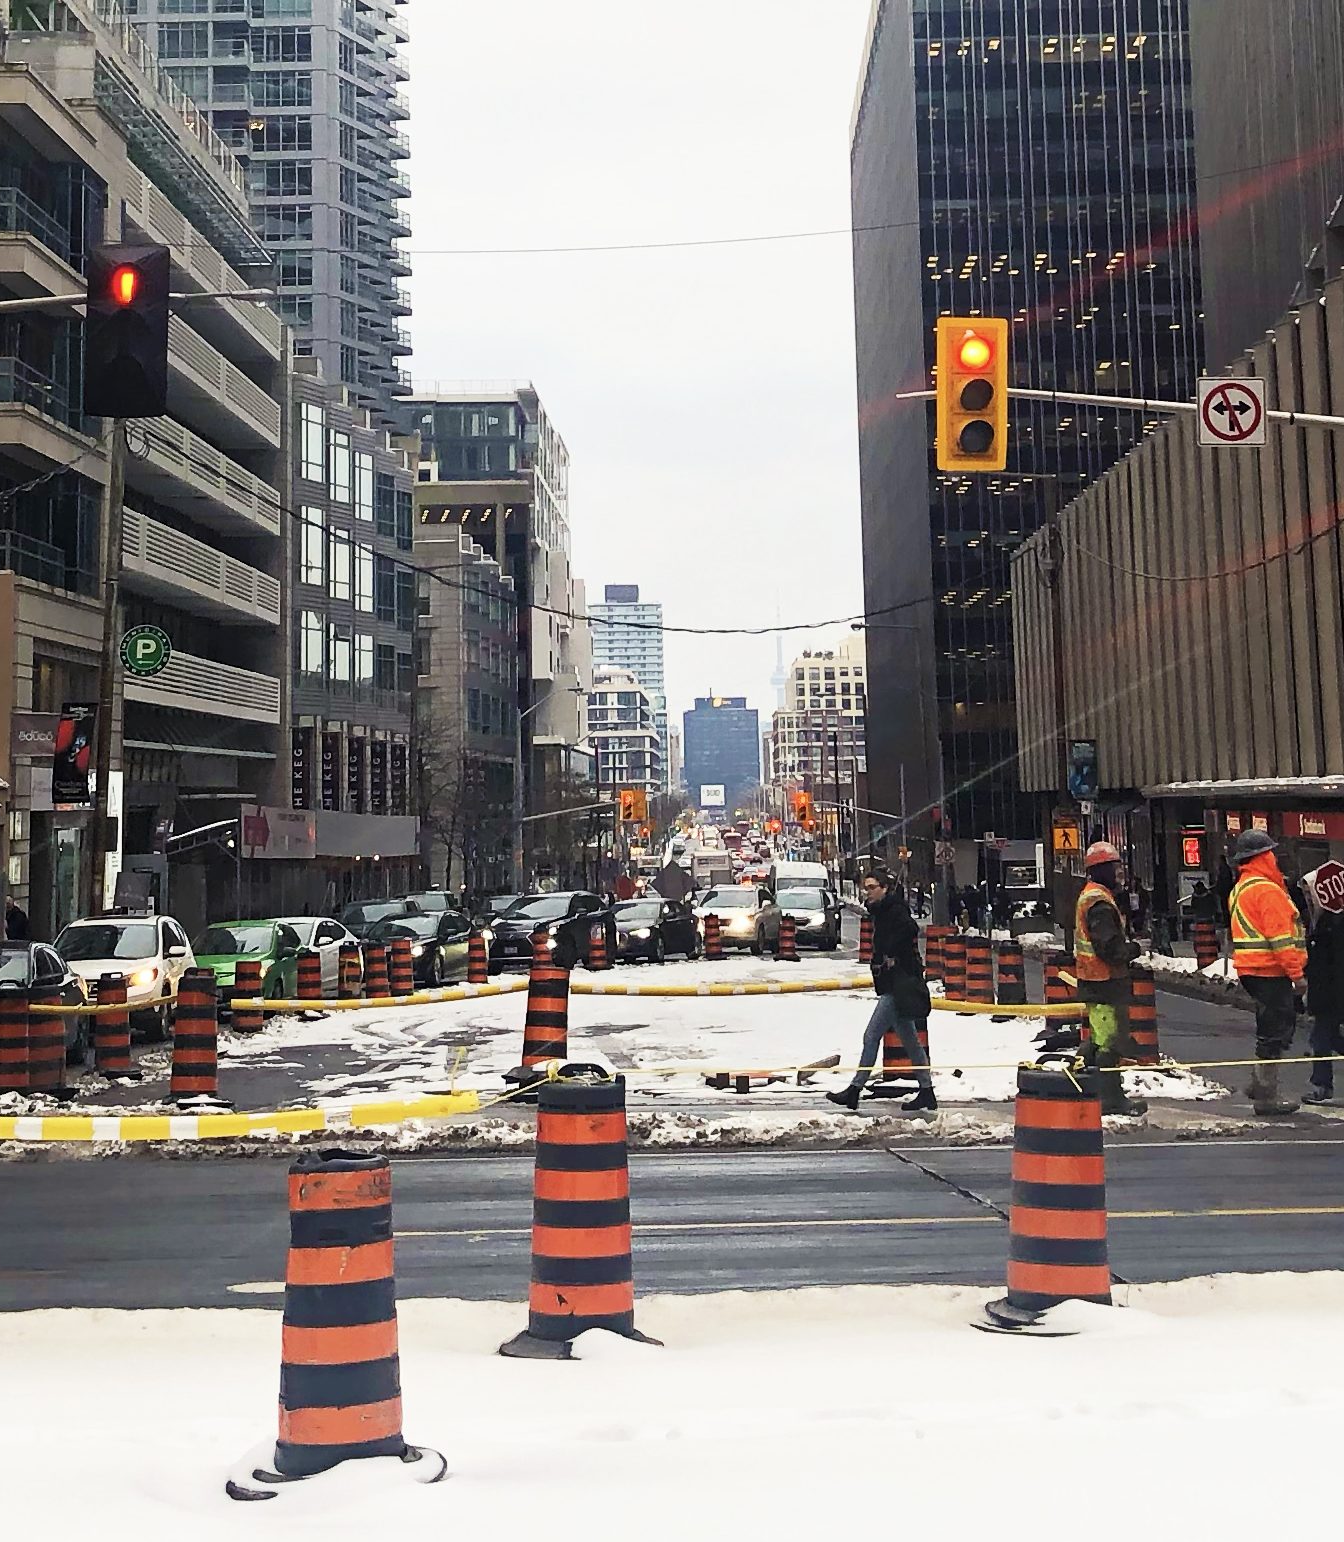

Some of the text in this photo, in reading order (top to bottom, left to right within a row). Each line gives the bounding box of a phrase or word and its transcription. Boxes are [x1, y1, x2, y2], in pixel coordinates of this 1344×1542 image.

[137, 640, 156, 659] P
[293, 748, 303, 779] KEG
[323, 751, 332, 780] KEG
